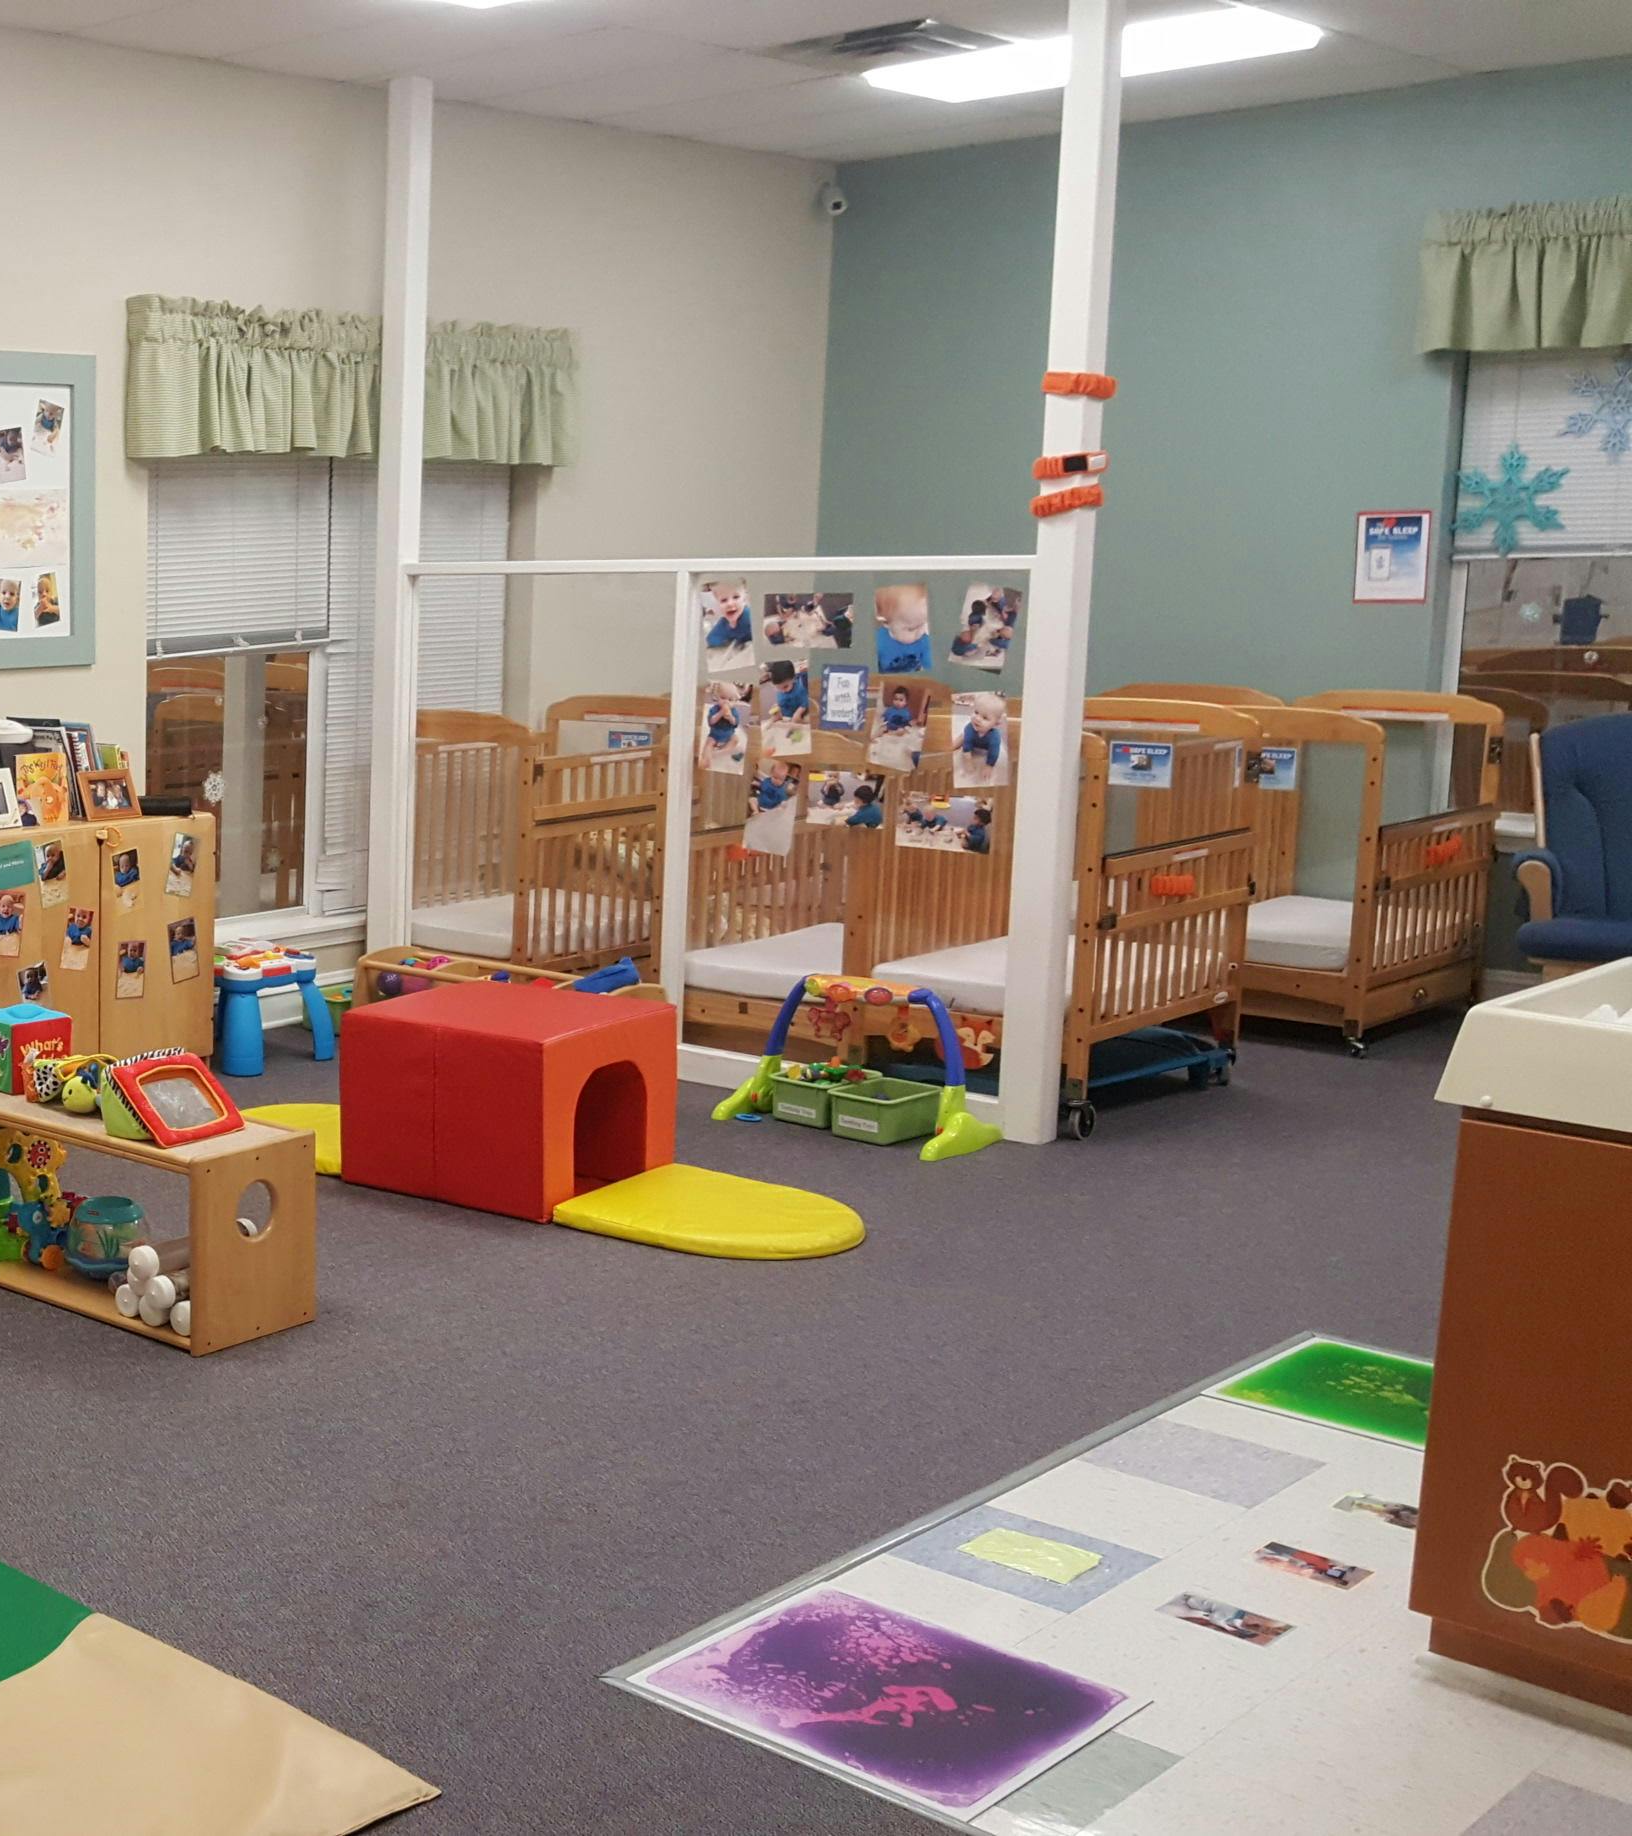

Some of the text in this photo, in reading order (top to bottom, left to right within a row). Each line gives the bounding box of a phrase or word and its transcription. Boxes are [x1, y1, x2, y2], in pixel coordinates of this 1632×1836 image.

[1392, 525, 1419, 535] SLEEP
[1147, 748, 1169, 756] SLEEP
[20, 1037, 64, 1056] What's
